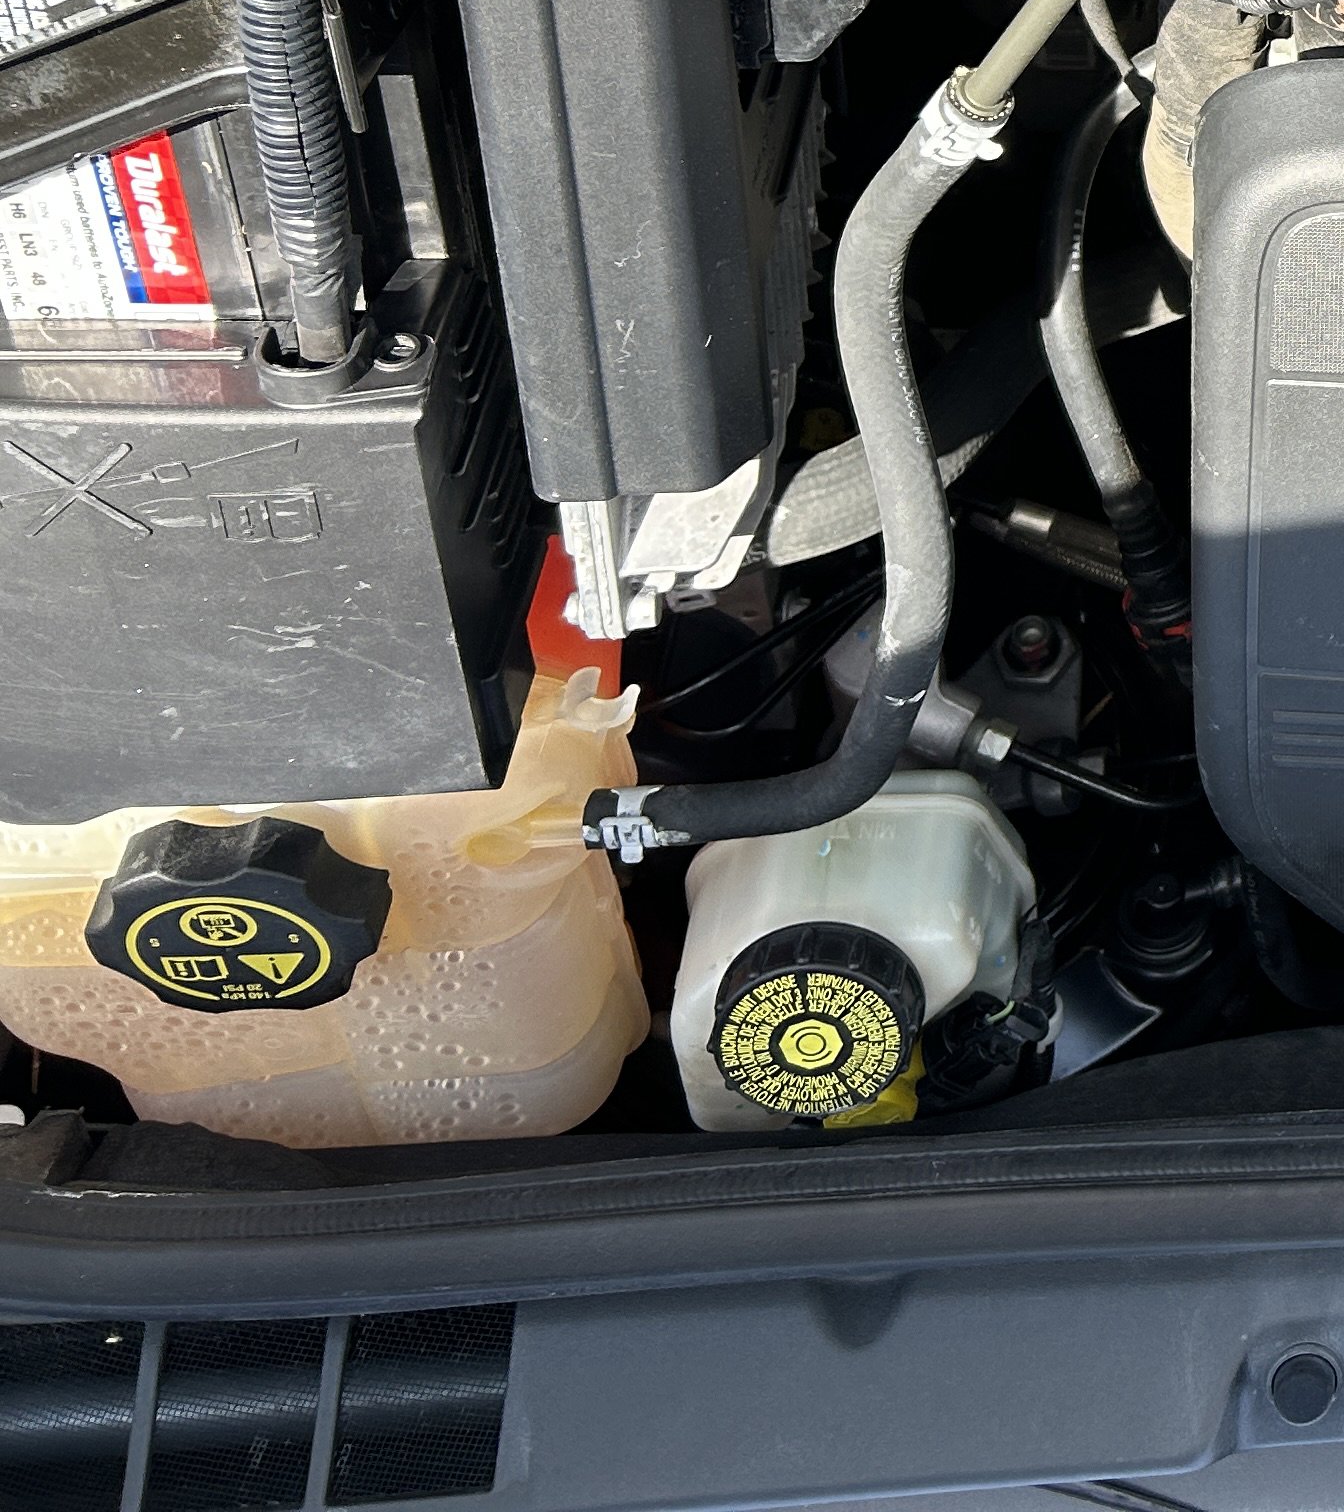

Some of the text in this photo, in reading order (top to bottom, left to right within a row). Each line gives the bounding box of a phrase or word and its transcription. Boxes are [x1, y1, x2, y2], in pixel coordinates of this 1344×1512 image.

[73, 190, 89, 214] used
[96, 154, 138, 273] PROVEN TOUGH
[125, 153, 189, 276] Duralast
[9, 202, 47, 286] H6 LN3 48
[80, 216, 99, 258] batteries
[0, 258, 19, 287] PARTS
[93, 261, 103, 270] to
[97, 273, 114, 319] AutoZone
[221, 991, 272, 1000] 140 kPa
[222, 984, 245, 992] PSI
[771, 990, 793, 1007] DOT
[794, 988, 803, 1000] 3
[806, 987, 832, 1000] ONLY
[834, 991, 855, 1009] USE
[746, 1000, 775, 1025] FREIN
[765, 1000, 805, 1026] SCELLE
[739, 1023, 757, 1038] DE
[754, 1023, 775, 1051] BIDON
[807, 973, 901, 1098] DOT 3 FLUID FROM A SEALED CONTAINER
[809, 999, 869, 1076] WARNING CLEAN FILLER
[720, 974, 853, 1114] ATTENTION NETTOYER LE BOUCHON AVANT DEPOSE
[737, 1038, 758, 1070] LIQUIDE
[860, 1042, 884, 1075] BEFORE
[746, 1066, 765, 1082] DU
[760, 1075, 782, 1094] QUE
[777, 1070, 839, 1089] PROVENANT
[846, 1070, 866, 1089] CAP
